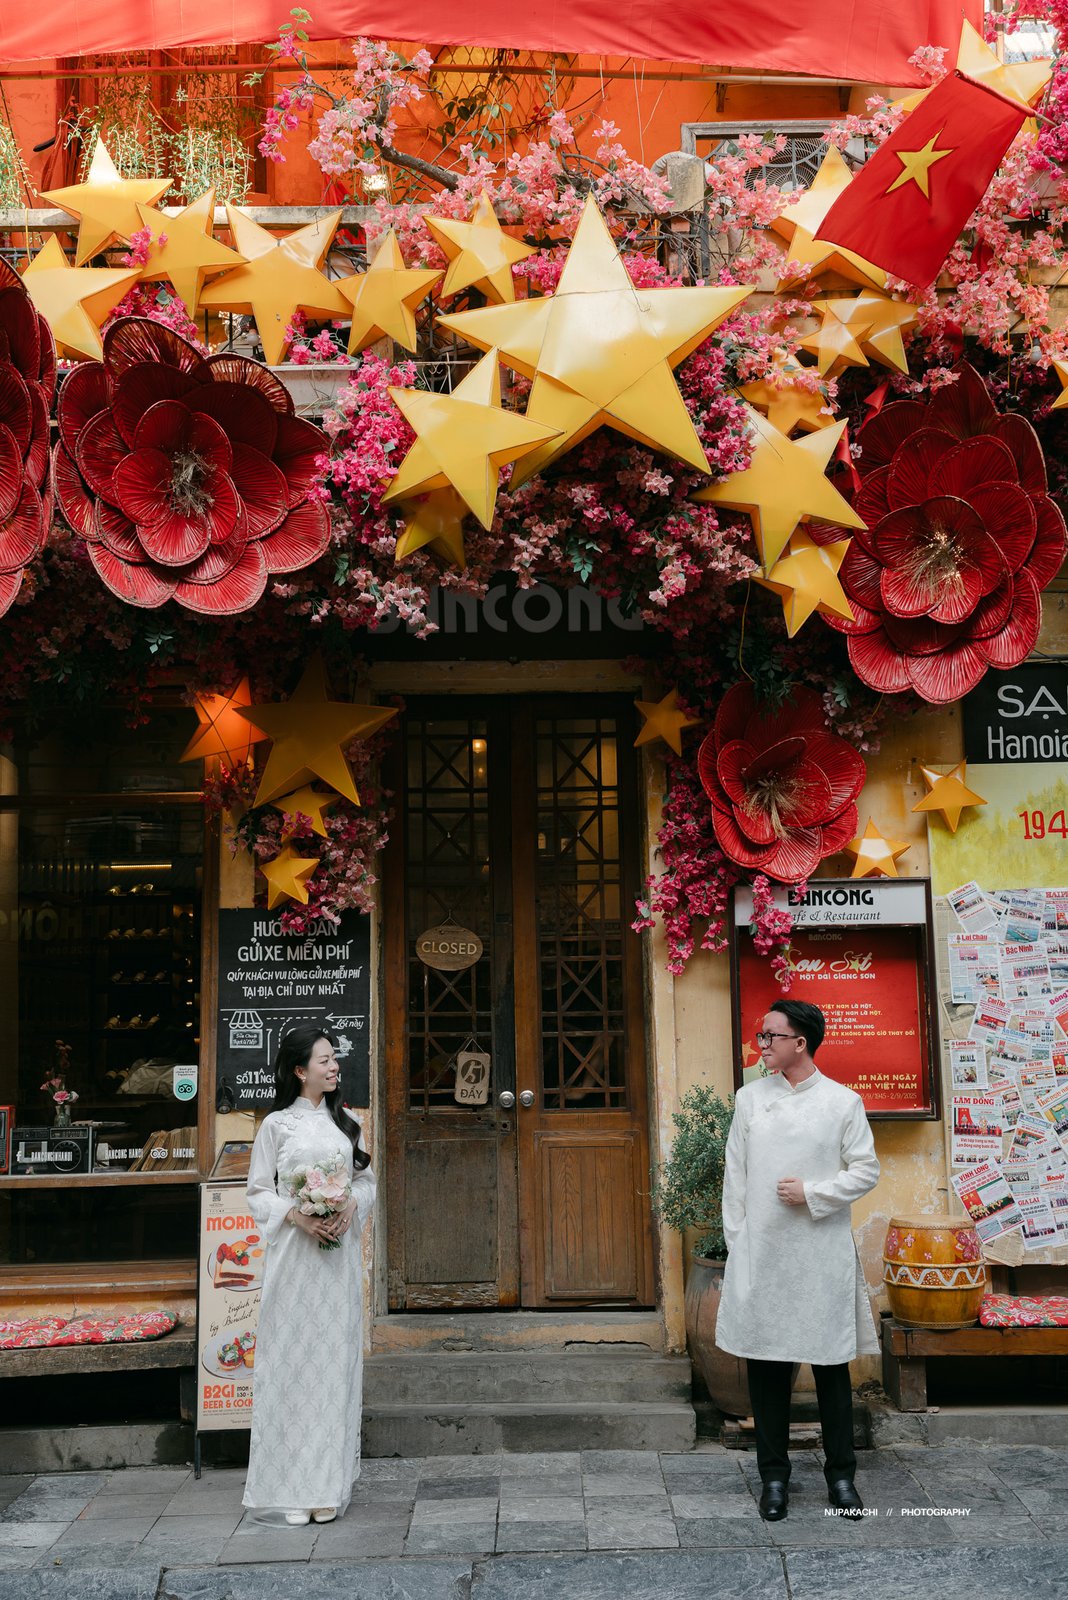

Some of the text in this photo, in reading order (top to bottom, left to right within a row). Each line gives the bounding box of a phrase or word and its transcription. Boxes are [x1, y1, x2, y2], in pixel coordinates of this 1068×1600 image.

[997, 684, 1068, 720] SẠ
[791, 910, 881, 924] afé & Restaurant
[264, 945, 284, 961] XE
[287, 939, 323, 961] MIỄN
[325, 939, 354, 960] PHÍ
[421, 941, 478, 955] CLOSED
[245, 968, 273, 981] KHÁCH
[274, 971, 287, 980] VUI
[287, 967, 308, 980] LÒNG
[276, 981, 293, 996] CHỈ
[295, 985, 316, 996] DUY
[318, 980, 346, 995] NHẤT
[239, 1088, 255, 1099] XIN
[460, 1085, 483, 1099] ĐẨY
[974, 1163, 989, 1174] LONG
[228, 1298, 250, 1317] English
[203, 1400, 223, 1409] BEER
[225, 1399, 231, 1408] &
